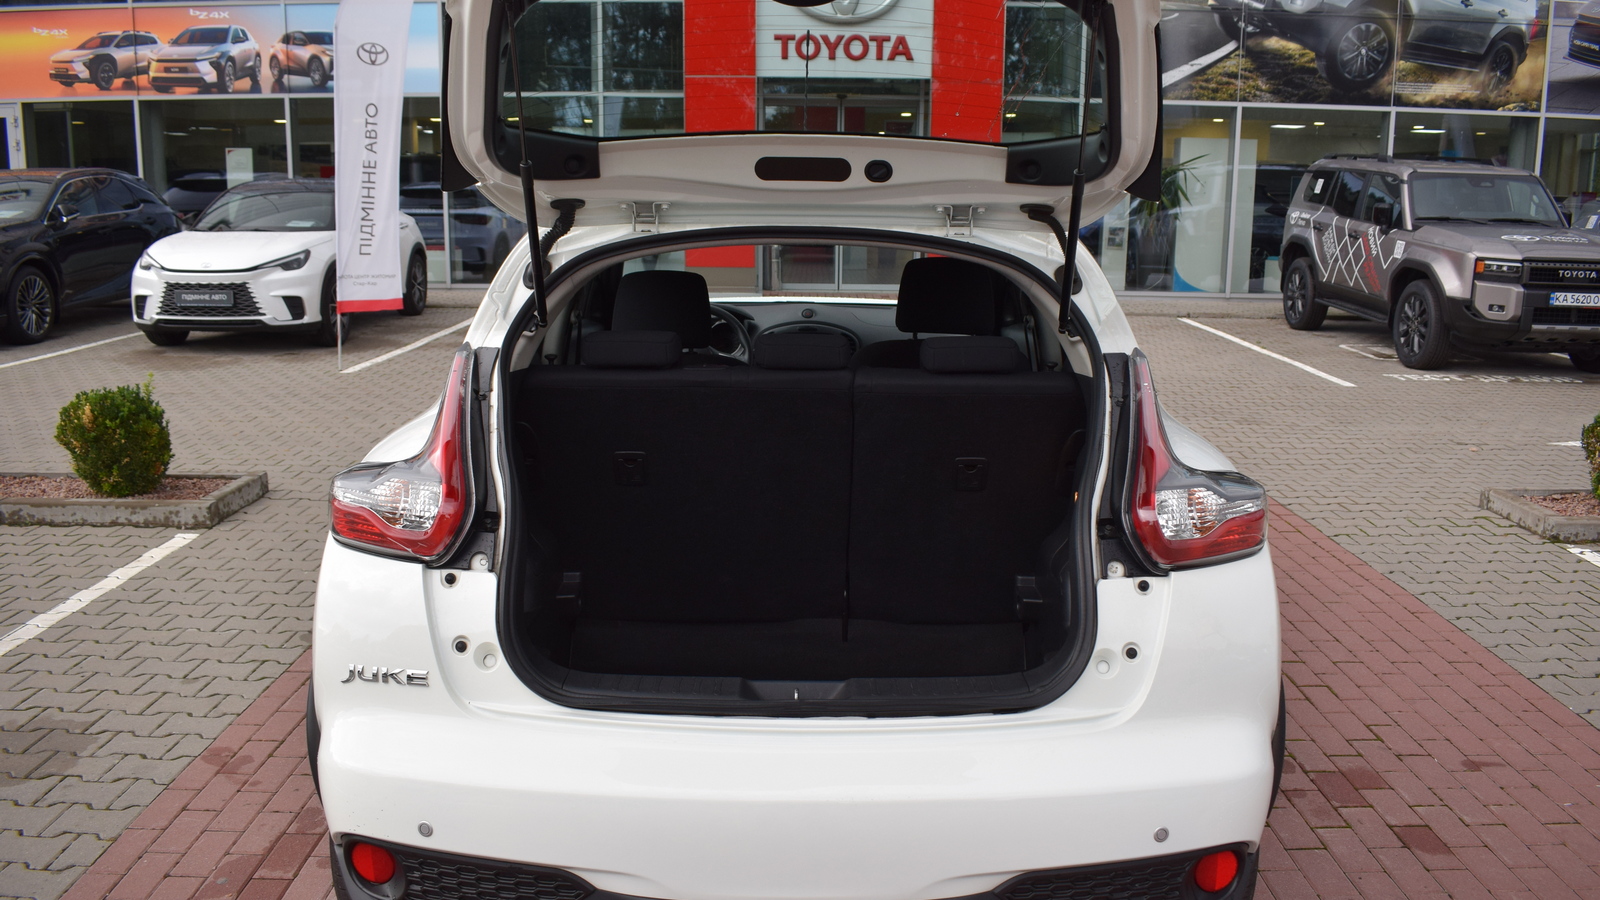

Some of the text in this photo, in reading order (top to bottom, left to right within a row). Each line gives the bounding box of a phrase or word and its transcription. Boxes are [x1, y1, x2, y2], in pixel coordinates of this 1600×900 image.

[774, 34, 914, 61] TOYOTA
[359, 103, 379, 256] ПІДМІННЕ АВТО
[1558, 270, 1597, 278] TOYOTA
[1554, 294, 1568, 304] KA
[1570, 294, 1591, 304] 5620
[341, 664, 430, 687] JUKE
